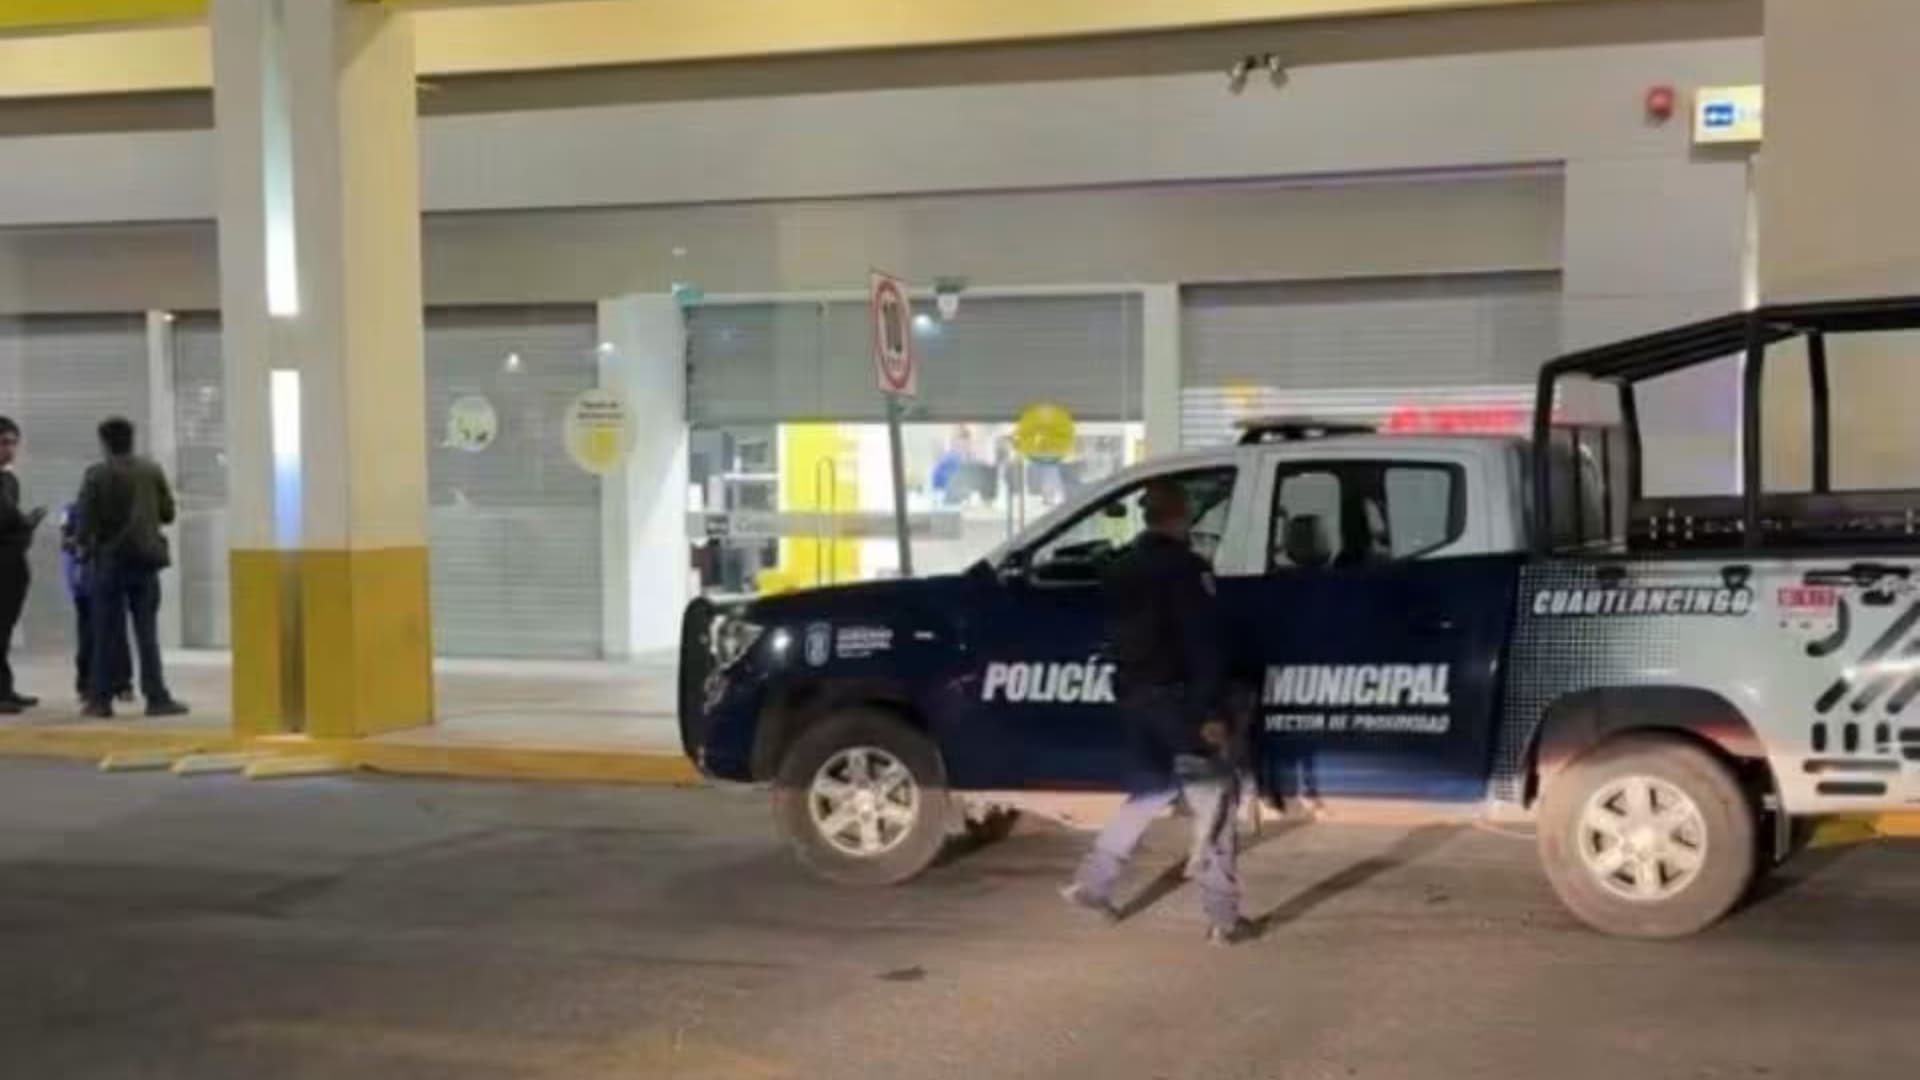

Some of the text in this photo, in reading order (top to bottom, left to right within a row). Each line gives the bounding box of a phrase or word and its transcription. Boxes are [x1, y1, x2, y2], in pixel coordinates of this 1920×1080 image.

[1533, 588, 1750, 616] CUAUTLANCINGO
[981, 654, 1449, 706] POLICÍA MUNICIPAL
